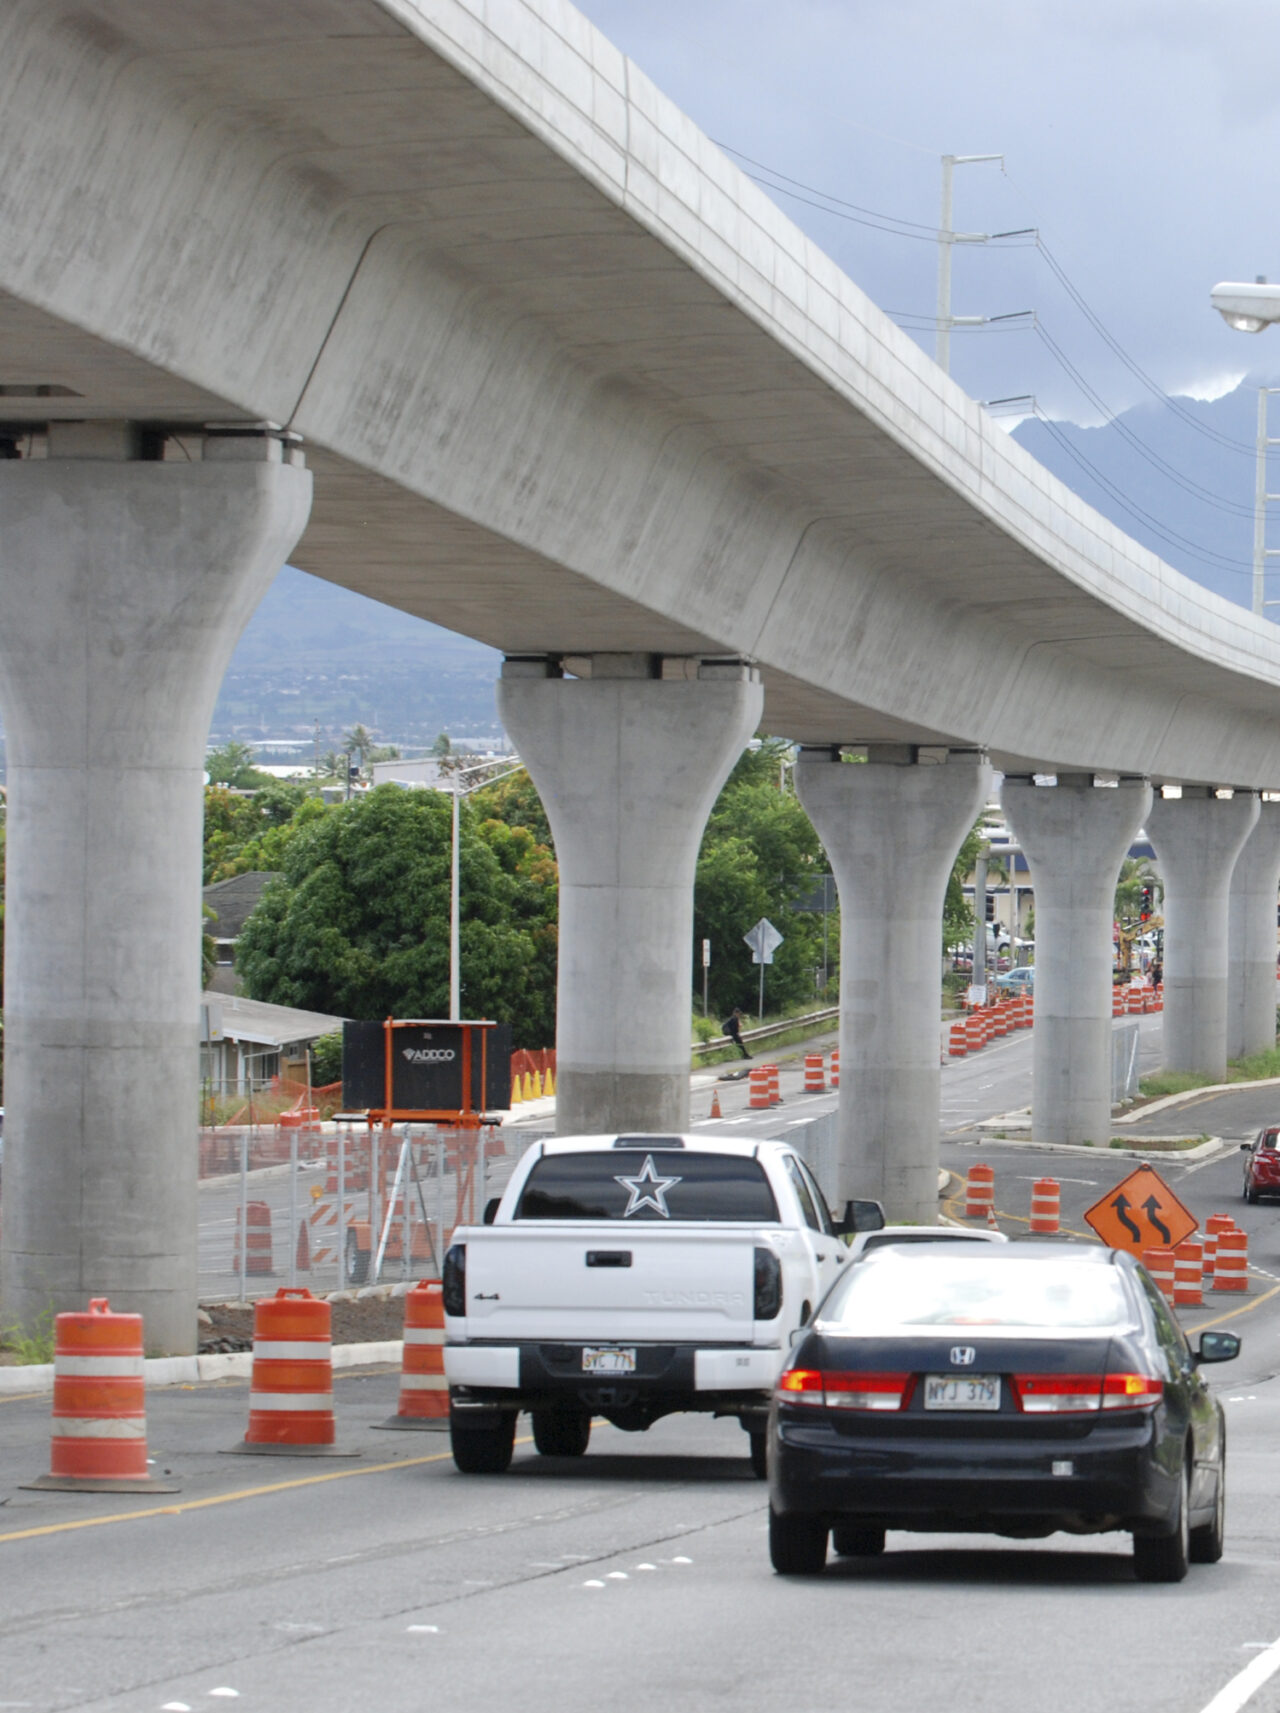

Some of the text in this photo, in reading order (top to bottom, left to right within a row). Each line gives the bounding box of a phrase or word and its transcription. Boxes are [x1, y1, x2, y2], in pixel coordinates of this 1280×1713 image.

[412, 1049, 456, 1061] ADDCO
[643, 1290, 745, 1304] TUNDRA
[928, 1382, 995, 1400] NYJ 379
